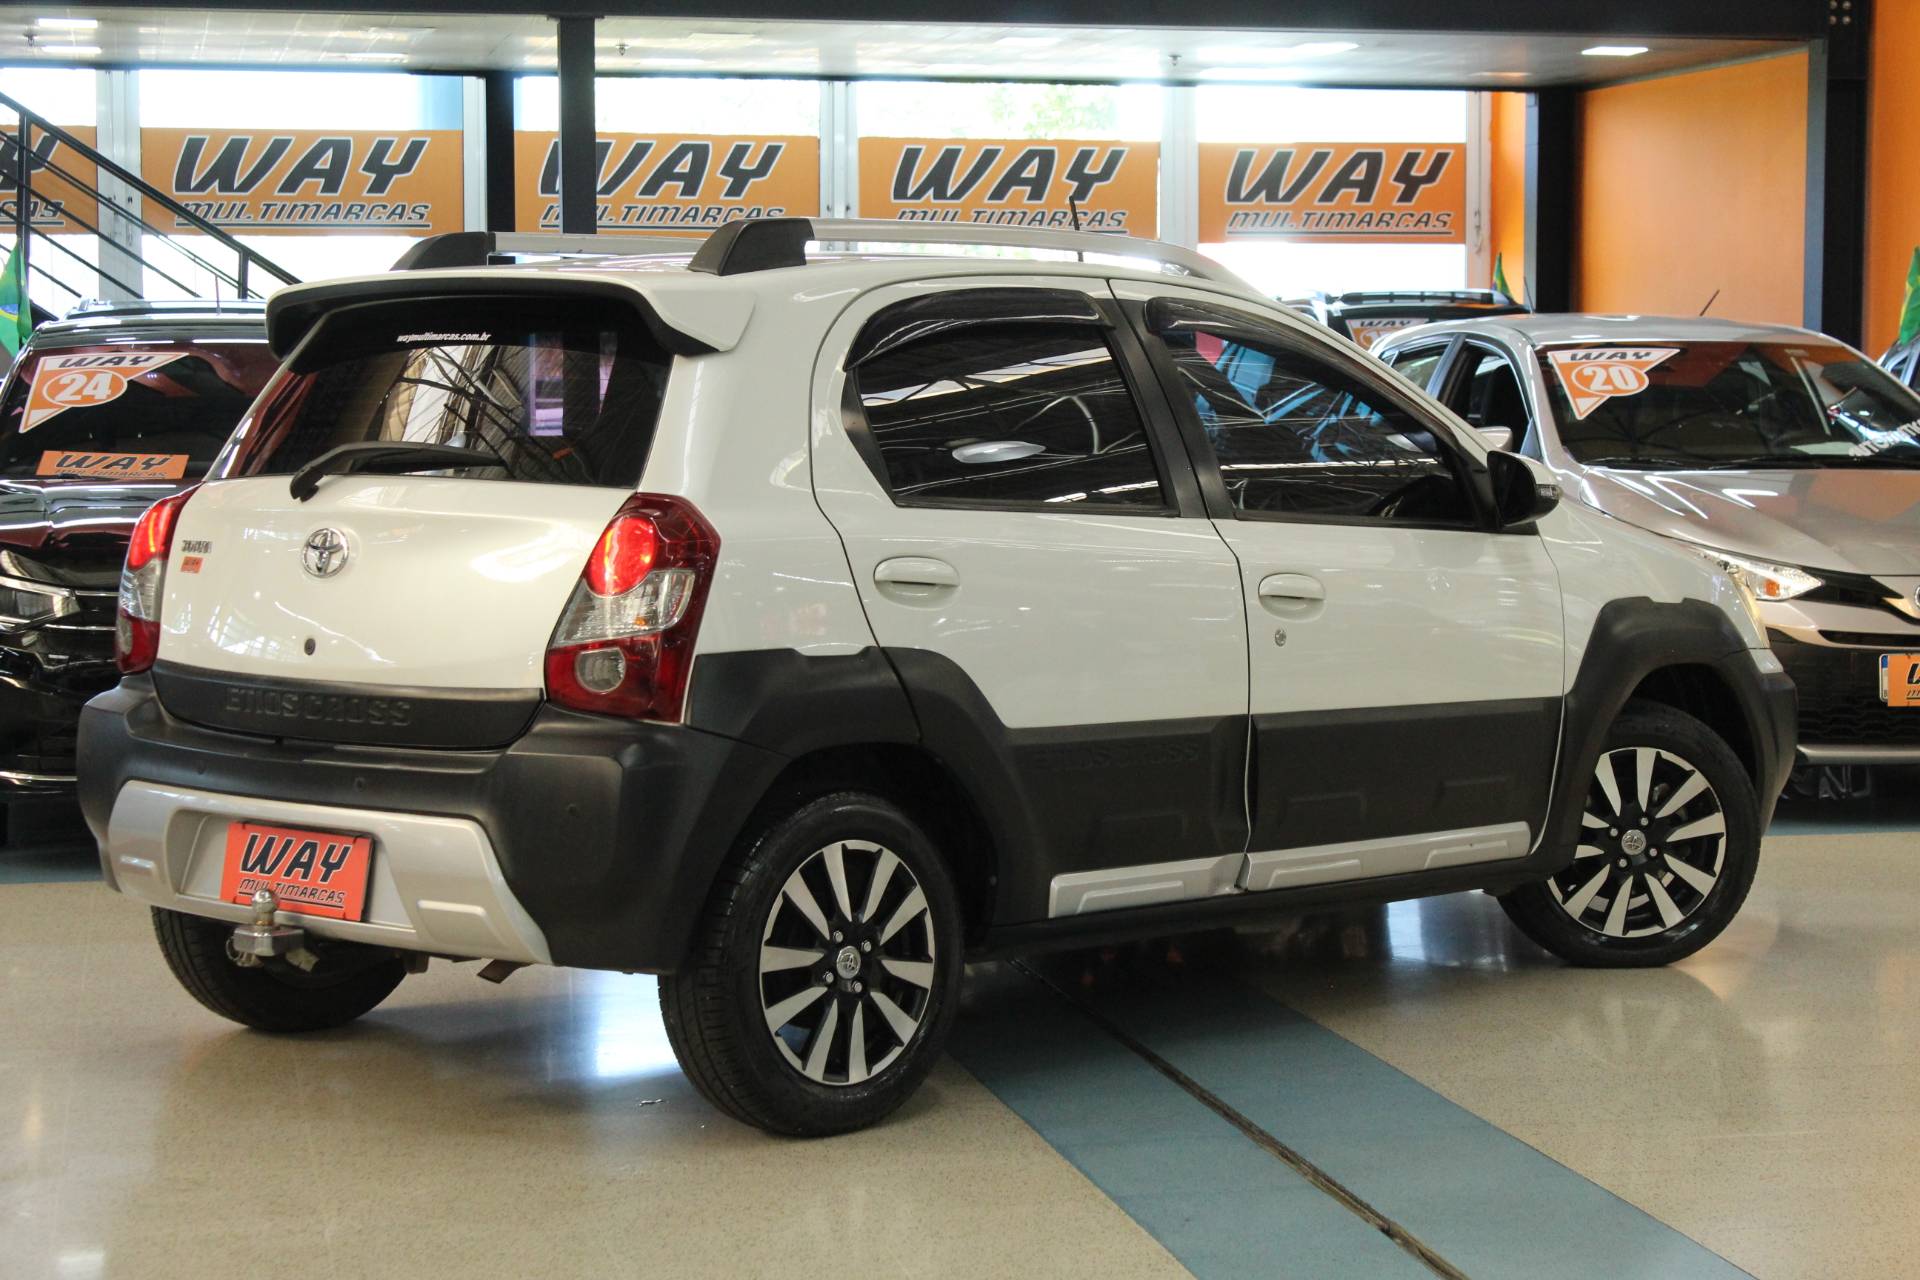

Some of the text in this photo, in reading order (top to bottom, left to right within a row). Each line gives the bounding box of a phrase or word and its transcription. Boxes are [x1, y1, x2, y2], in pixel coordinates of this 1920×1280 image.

[173, 135, 431, 196] WAY
[538, 139, 786, 199] WAY
[891, 145, 1128, 204] WAY
[1225, 148, 1454, 205] WAY
[180, 201, 430, 221] MULTIMARCAS
[1228, 210, 1453, 229] MULTIMARCAS
[1360, 319, 1411, 328] WAY
[59, 355, 154, 368] WAY
[1571, 351, 1652, 362] WAY
[54, 373, 112, 401] 24
[1583, 366, 1640, 391] 20
[56, 454, 170, 470] WAY
[239, 832, 352, 884] WAY
